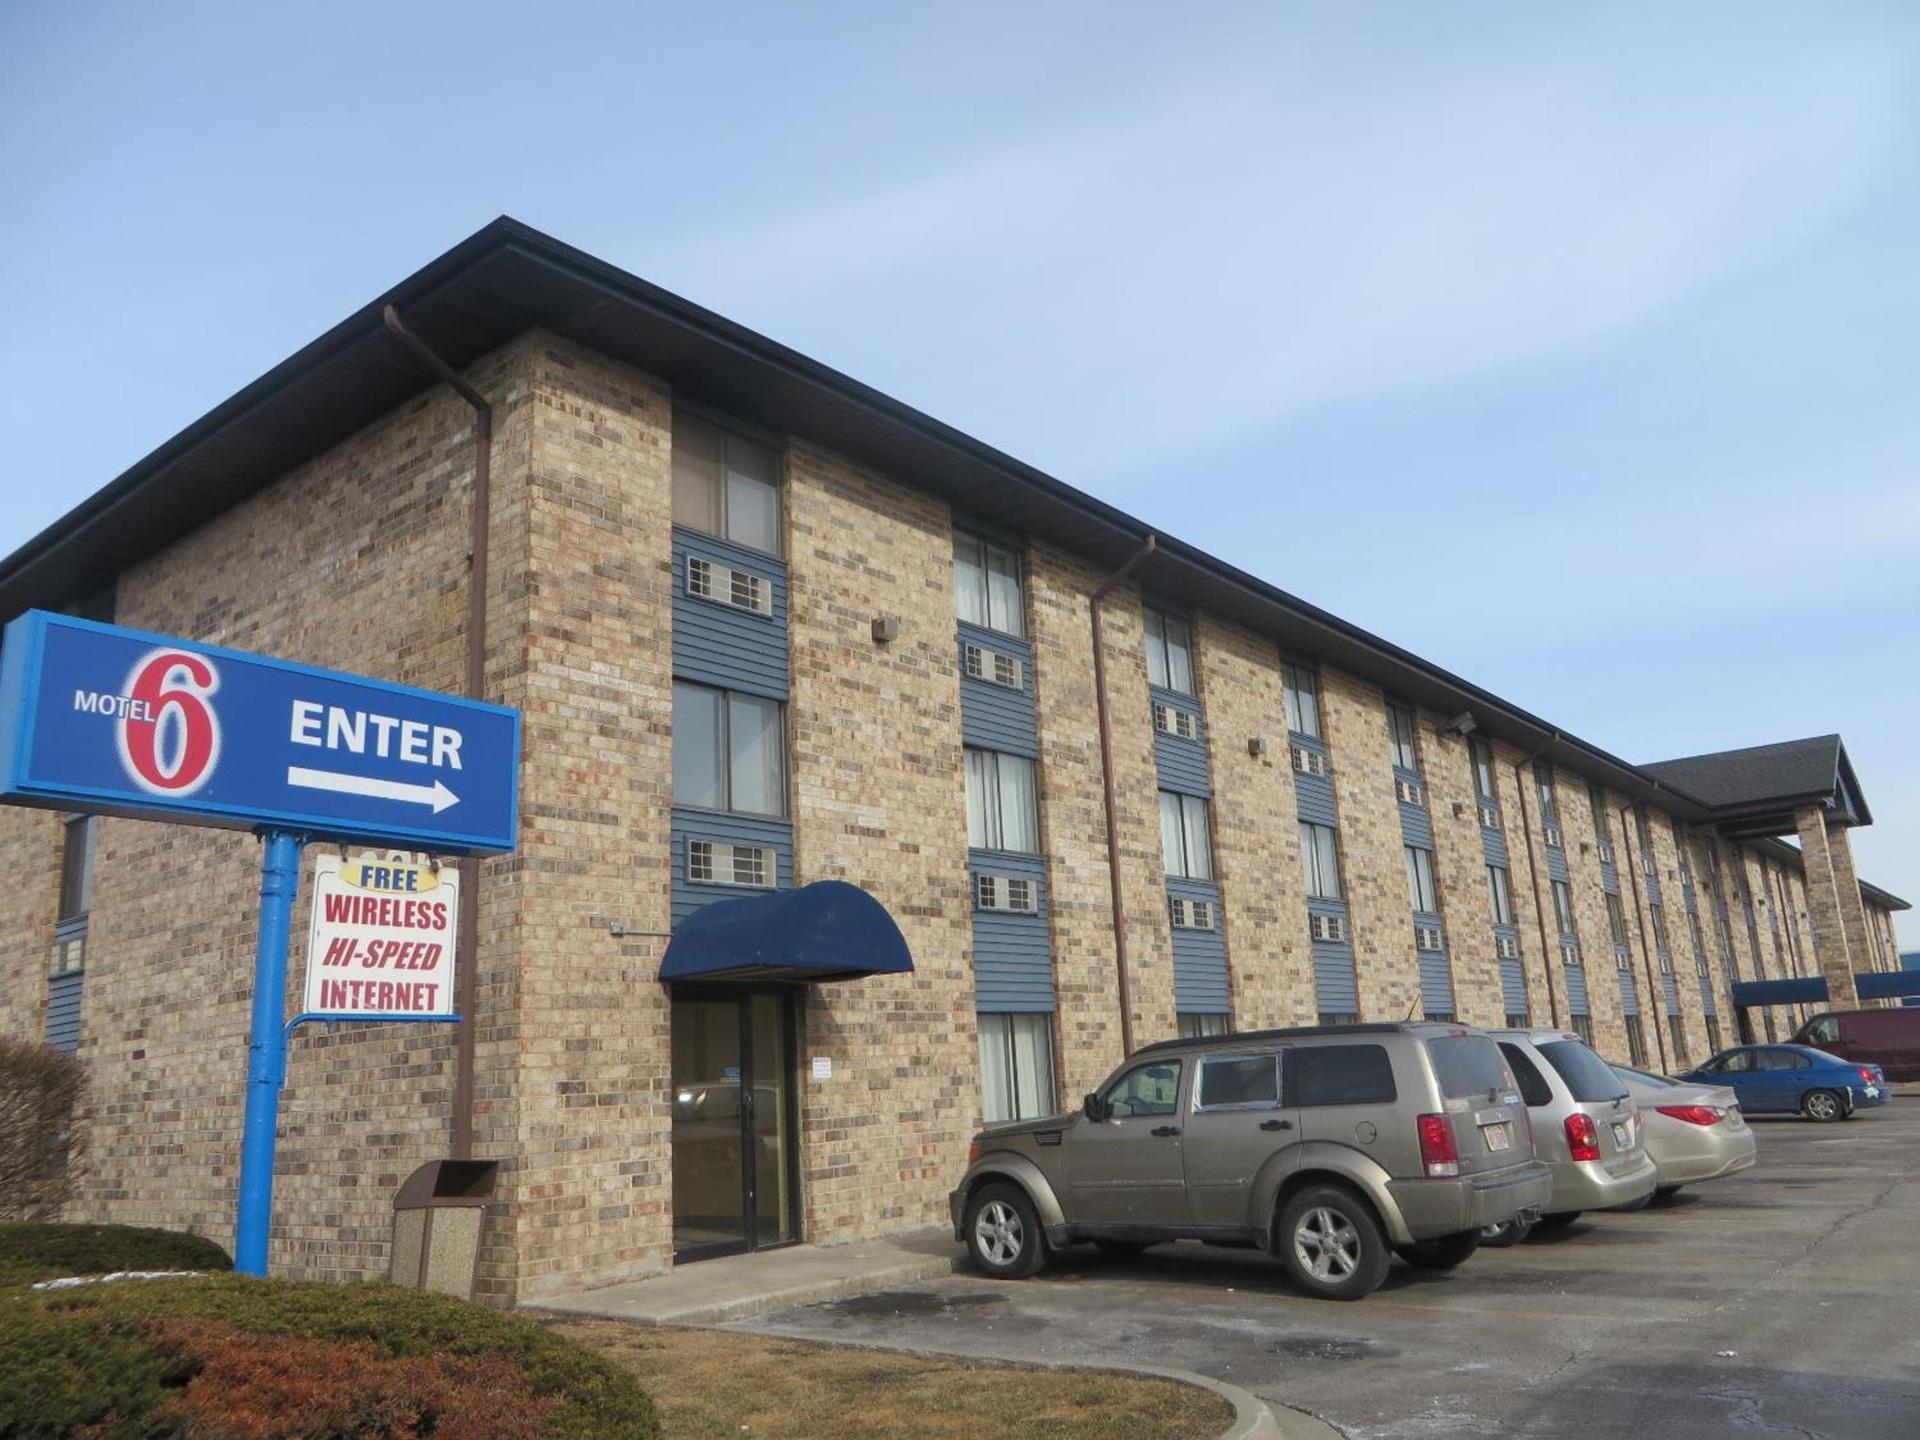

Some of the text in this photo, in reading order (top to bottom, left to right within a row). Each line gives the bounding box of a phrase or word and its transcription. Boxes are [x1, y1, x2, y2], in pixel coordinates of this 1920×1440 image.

[74, 650, 217, 793] MOTEL 6
[290, 699, 464, 770] ENTER
[360, 864, 418, 892] FREE
[324, 893, 447, 931] WIRELESS
[322, 937, 442, 971] HI-SPEED
[319, 979, 439, 1012] INTERNET
